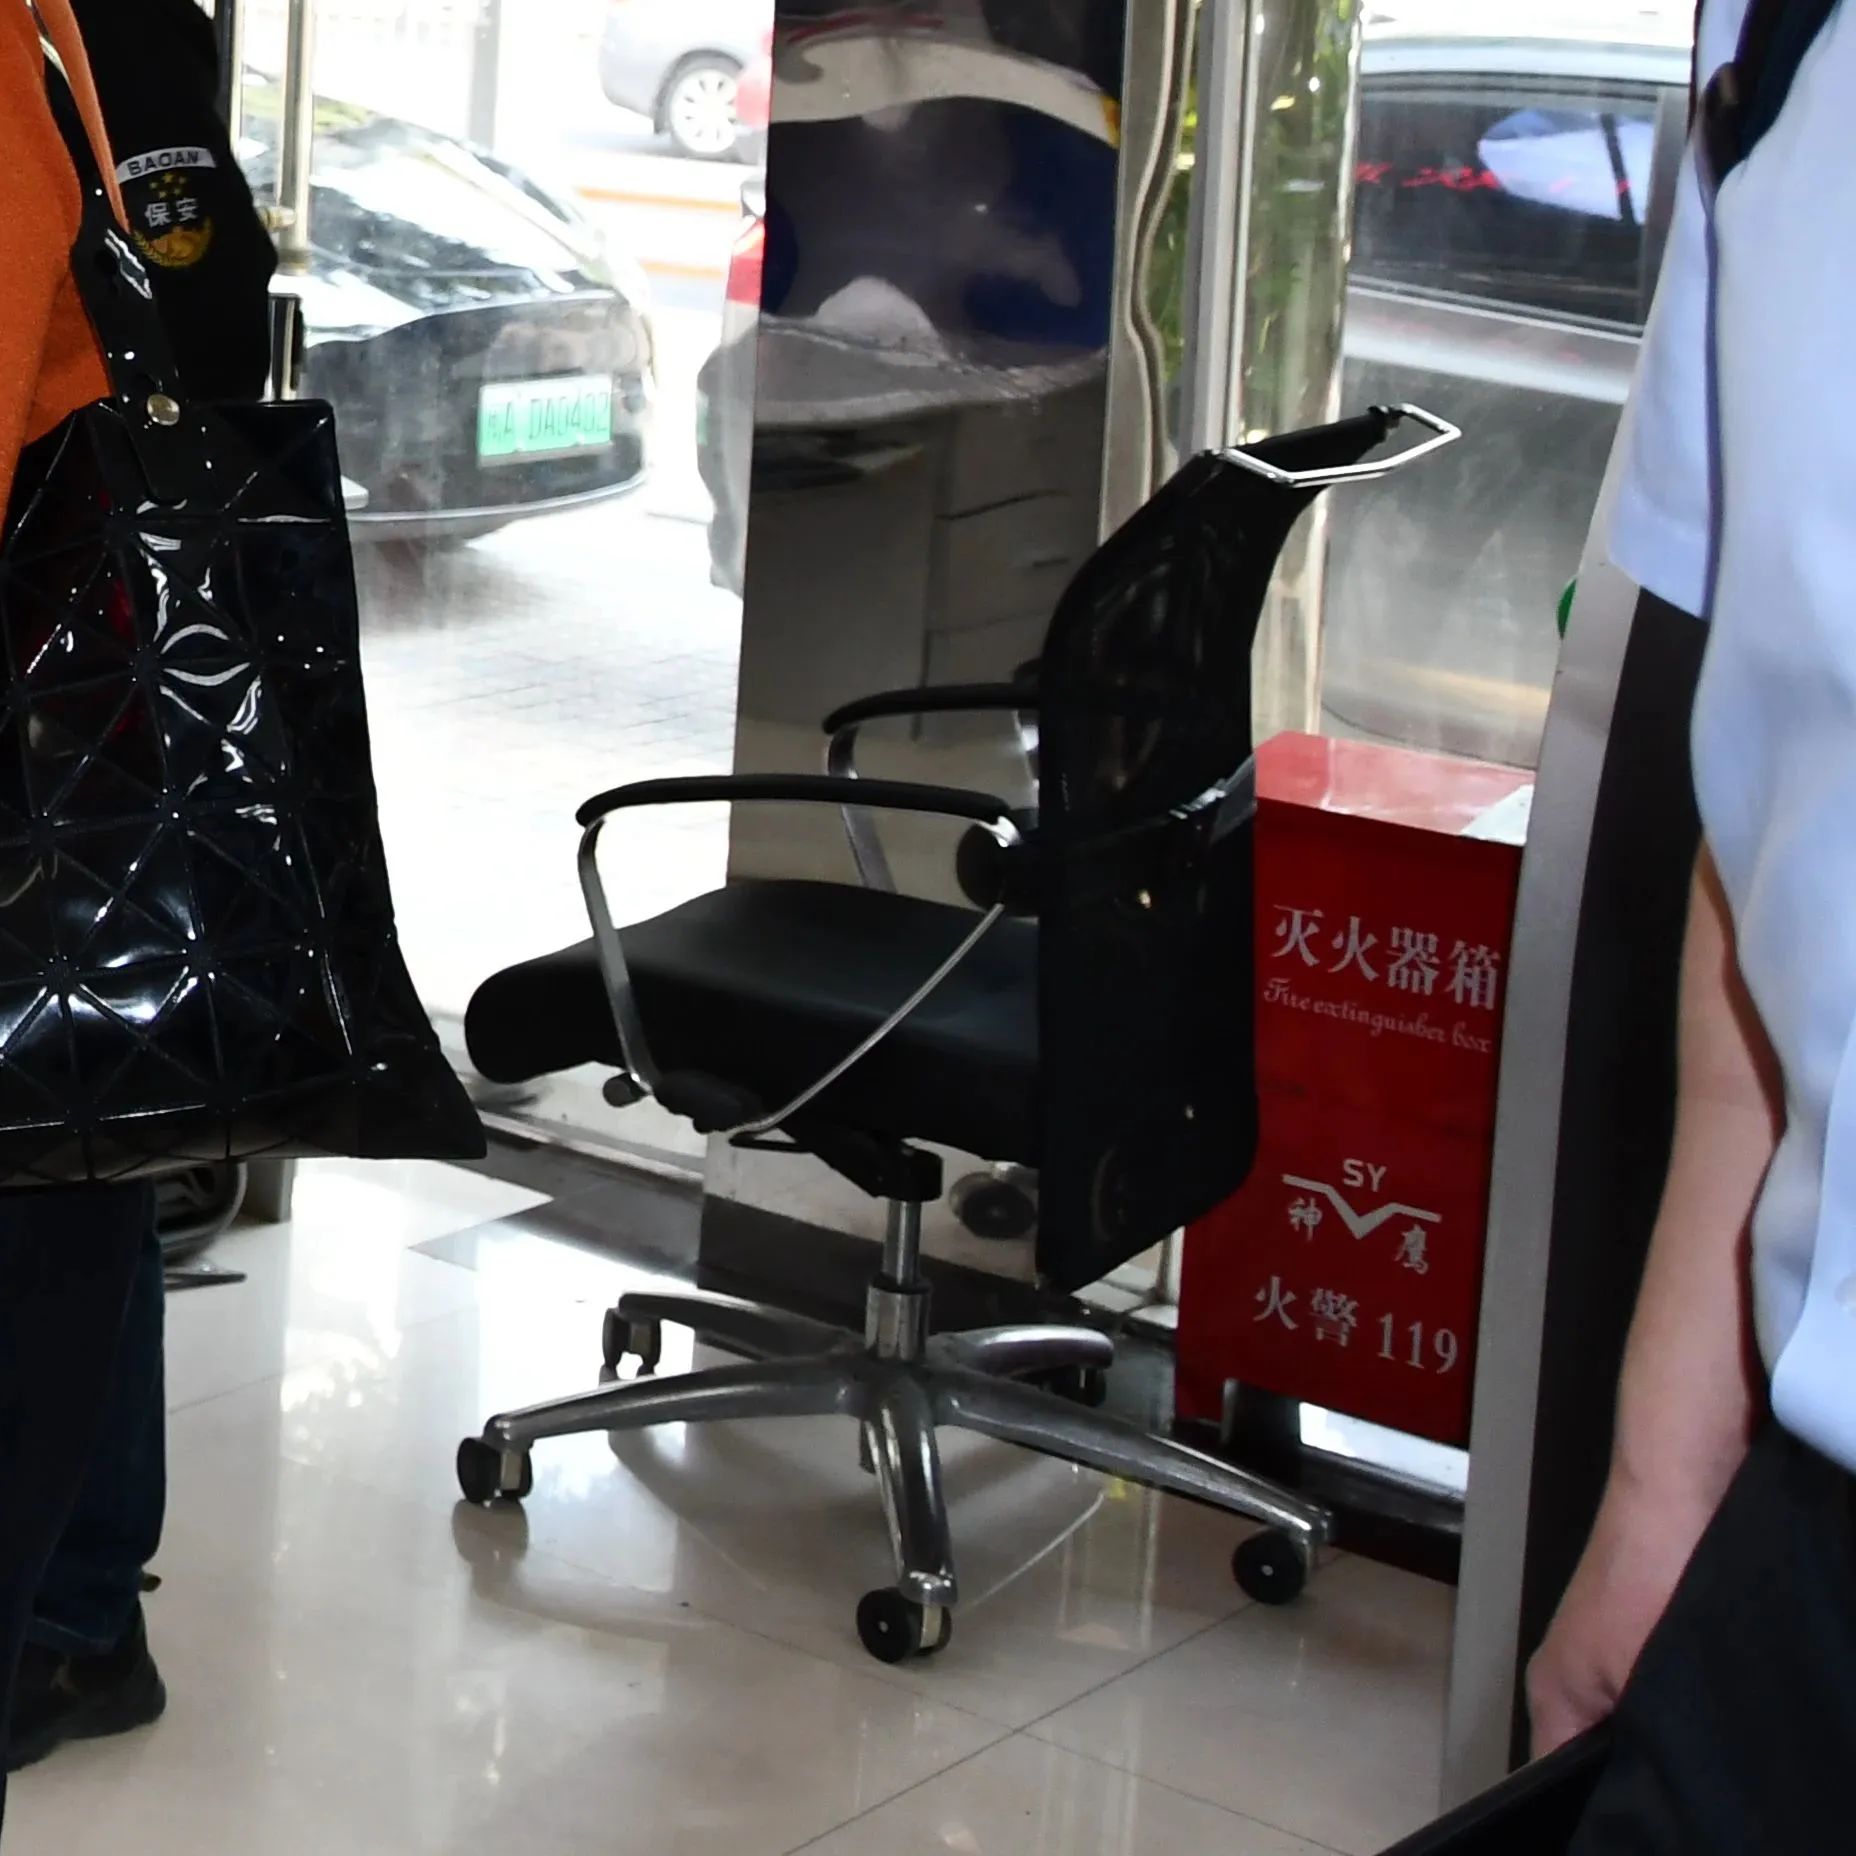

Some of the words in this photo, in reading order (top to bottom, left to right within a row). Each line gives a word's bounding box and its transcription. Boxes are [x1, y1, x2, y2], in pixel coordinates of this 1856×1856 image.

[126, 150, 199, 176] BAOAN
[144, 197, 199, 228] 保安
[1271, 904, 1501, 1010] 灭火器箱
[1263, 977, 1311, 1010] Fire
[1342, 1158, 1388, 1193] SY
[1287, 1197, 1323, 1241] 神
[1253, 1275, 1360, 1348] 火警
[1377, 1312, 1459, 1375] 119
